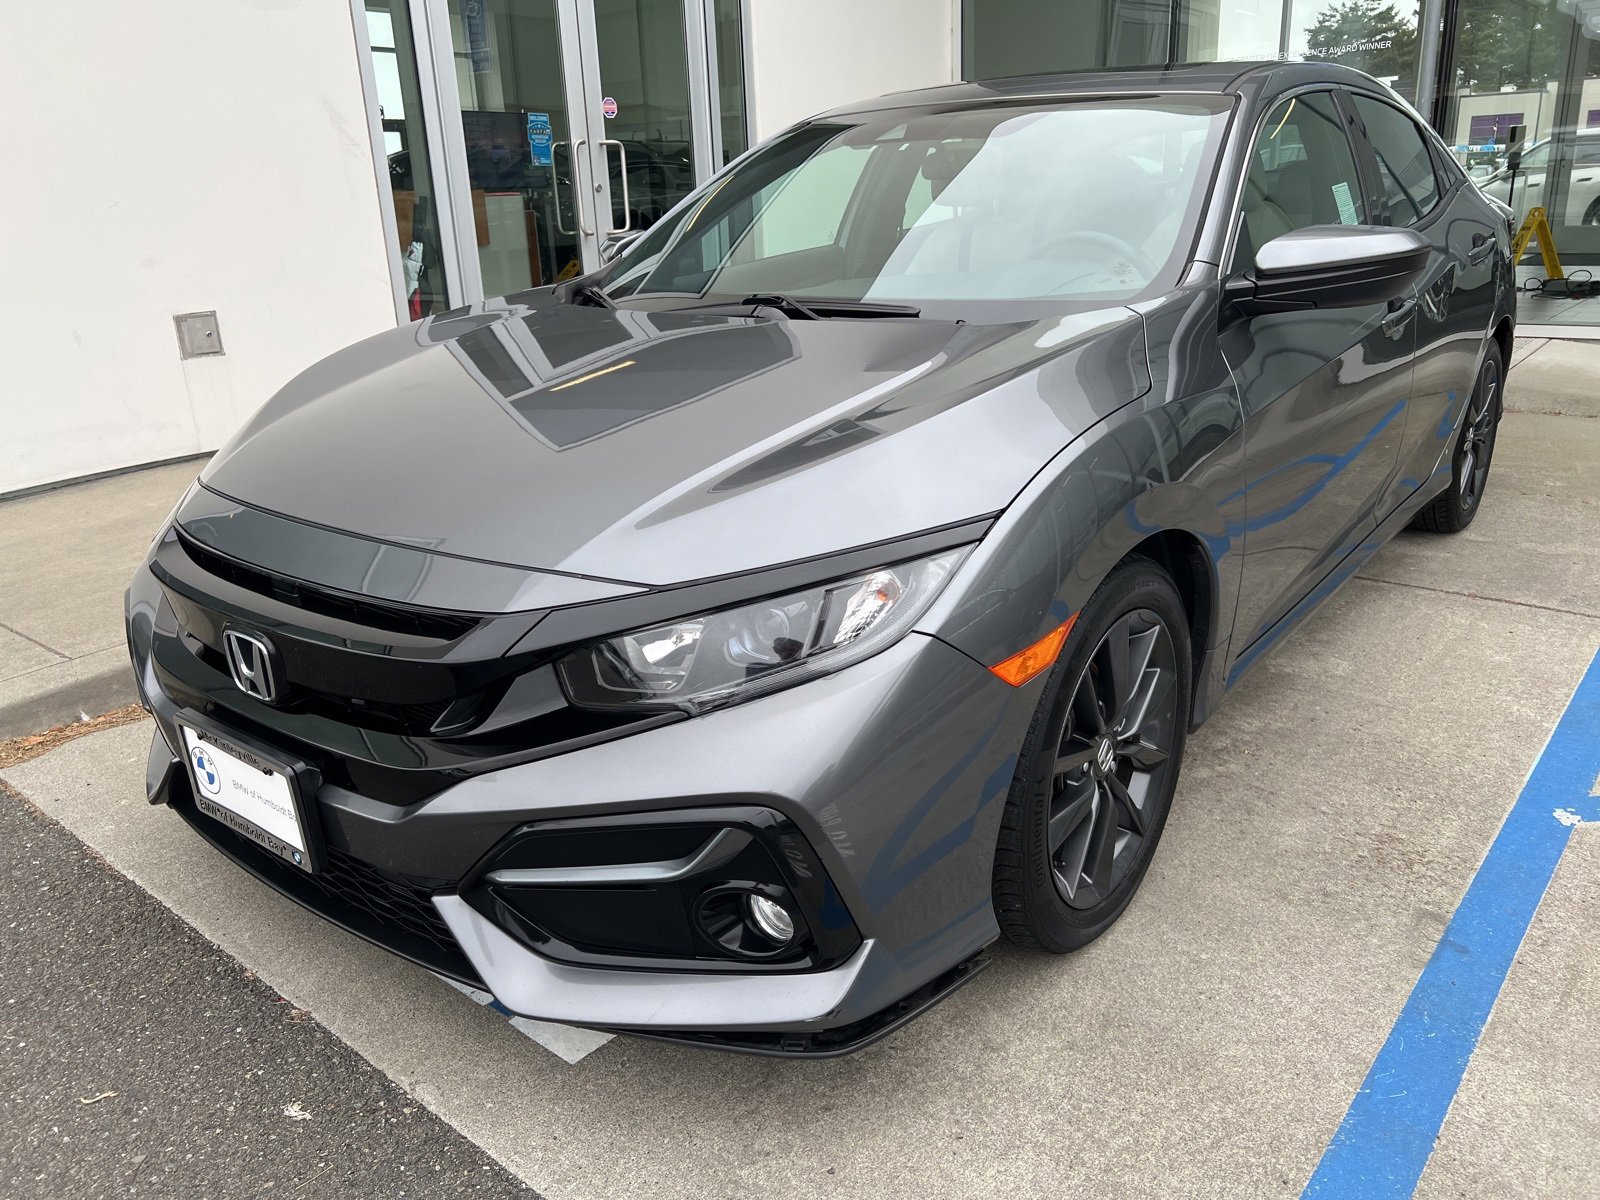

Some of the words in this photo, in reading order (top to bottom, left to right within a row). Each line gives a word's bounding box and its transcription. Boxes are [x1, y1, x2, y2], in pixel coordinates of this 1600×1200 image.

[1329, 43, 1358, 54] AWARD
[1359, 40, 1392, 51] WINNER
[232, 779, 249, 795] BMW
[250, 790, 256, 799] of
[257, 792, 287, 816] Humboldt
[221, 811, 228, 822] of
[229, 814, 266, 843] Humboldt
